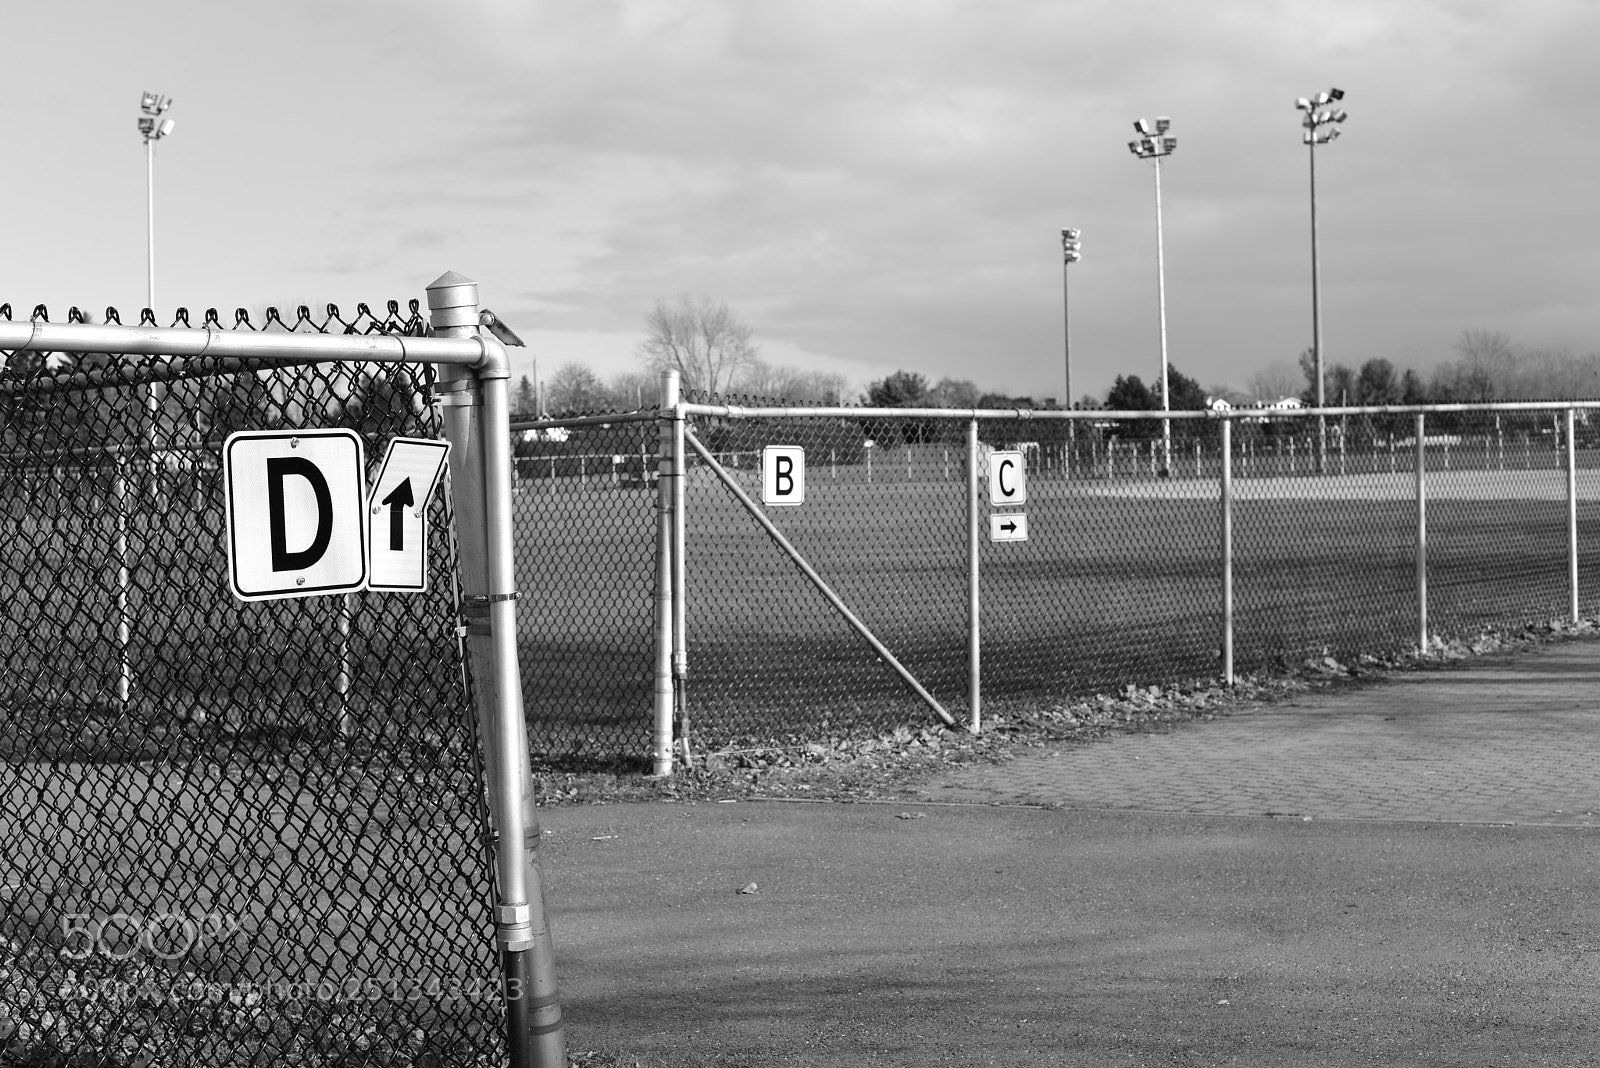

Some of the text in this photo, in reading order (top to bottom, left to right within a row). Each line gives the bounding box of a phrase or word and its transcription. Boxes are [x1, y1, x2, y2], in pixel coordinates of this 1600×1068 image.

[775, 456, 794, 496] B
[999, 460, 1016, 497] C
[267, 457, 333, 572] D
